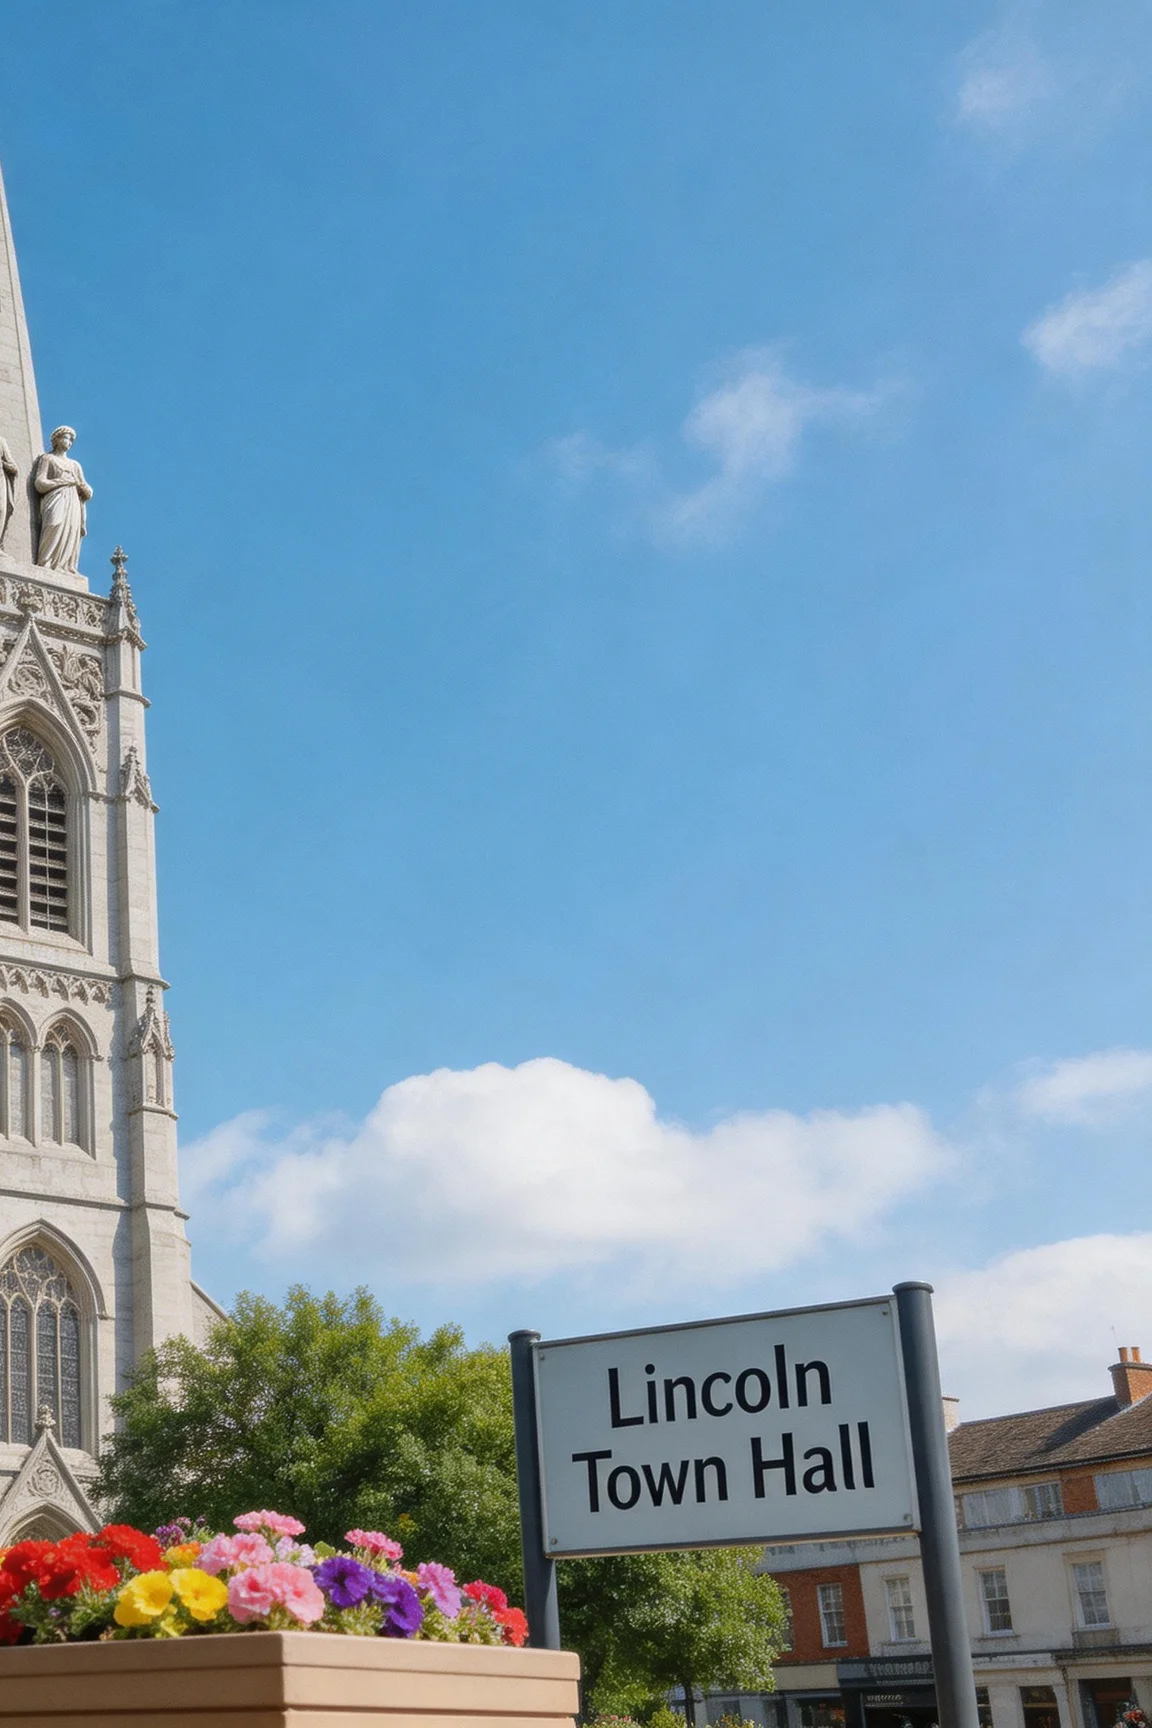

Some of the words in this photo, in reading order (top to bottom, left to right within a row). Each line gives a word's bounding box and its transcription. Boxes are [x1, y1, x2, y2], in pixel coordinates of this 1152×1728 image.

[607, 1343, 832, 1429] Lincoln
[572, 1449, 728, 1513] Town
[750, 1421, 876, 1499] Hall
